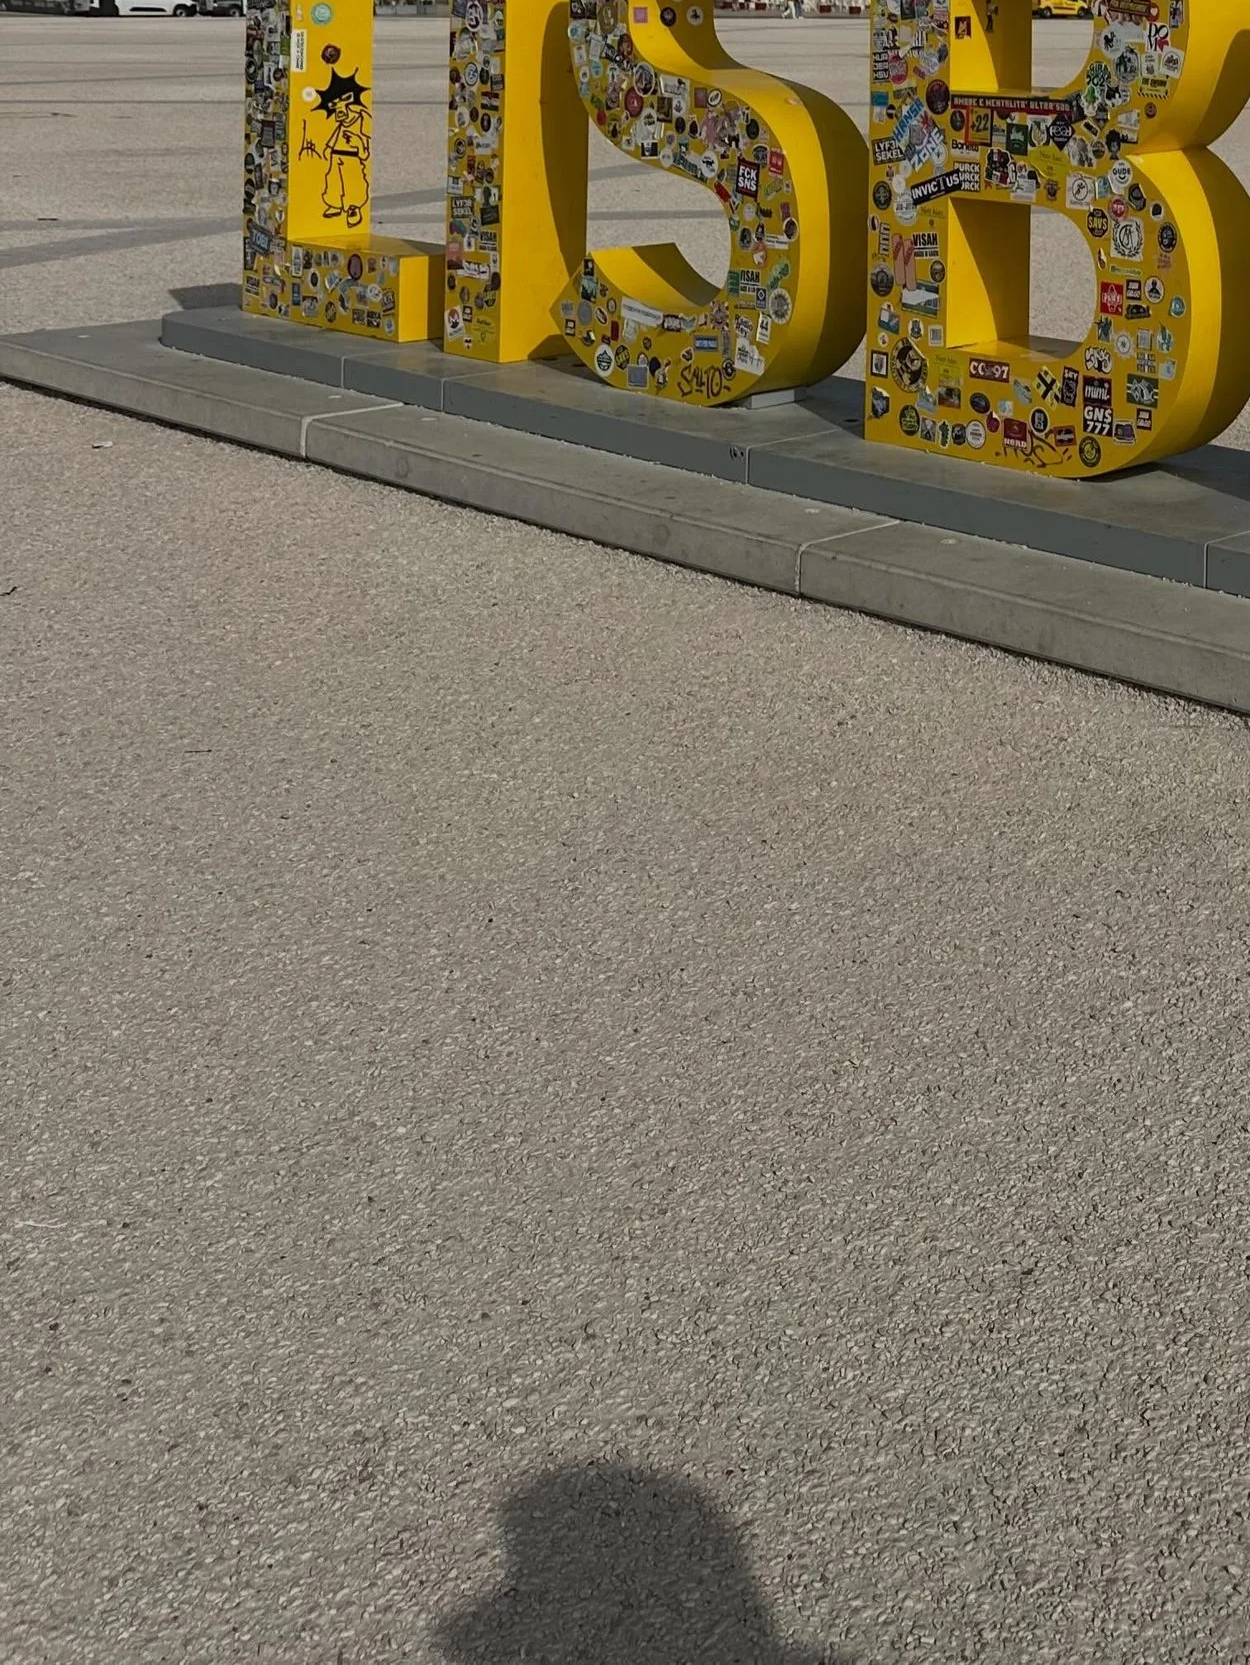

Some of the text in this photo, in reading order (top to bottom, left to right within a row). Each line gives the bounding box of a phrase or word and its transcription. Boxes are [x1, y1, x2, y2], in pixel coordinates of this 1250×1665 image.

[893, 96, 926, 143] HANSA
[875, 148, 904, 162] SEKEL
[909, 125, 945, 172] ZONE
[739, 166, 758, 182] FCK
[959, 171, 980, 182] URCK
[737, 176, 757, 192] SNS
[911, 170, 961, 199] INVICTUS
[912, 232, 939, 247] VISAH
[1086, 421, 1110, 436] 777
